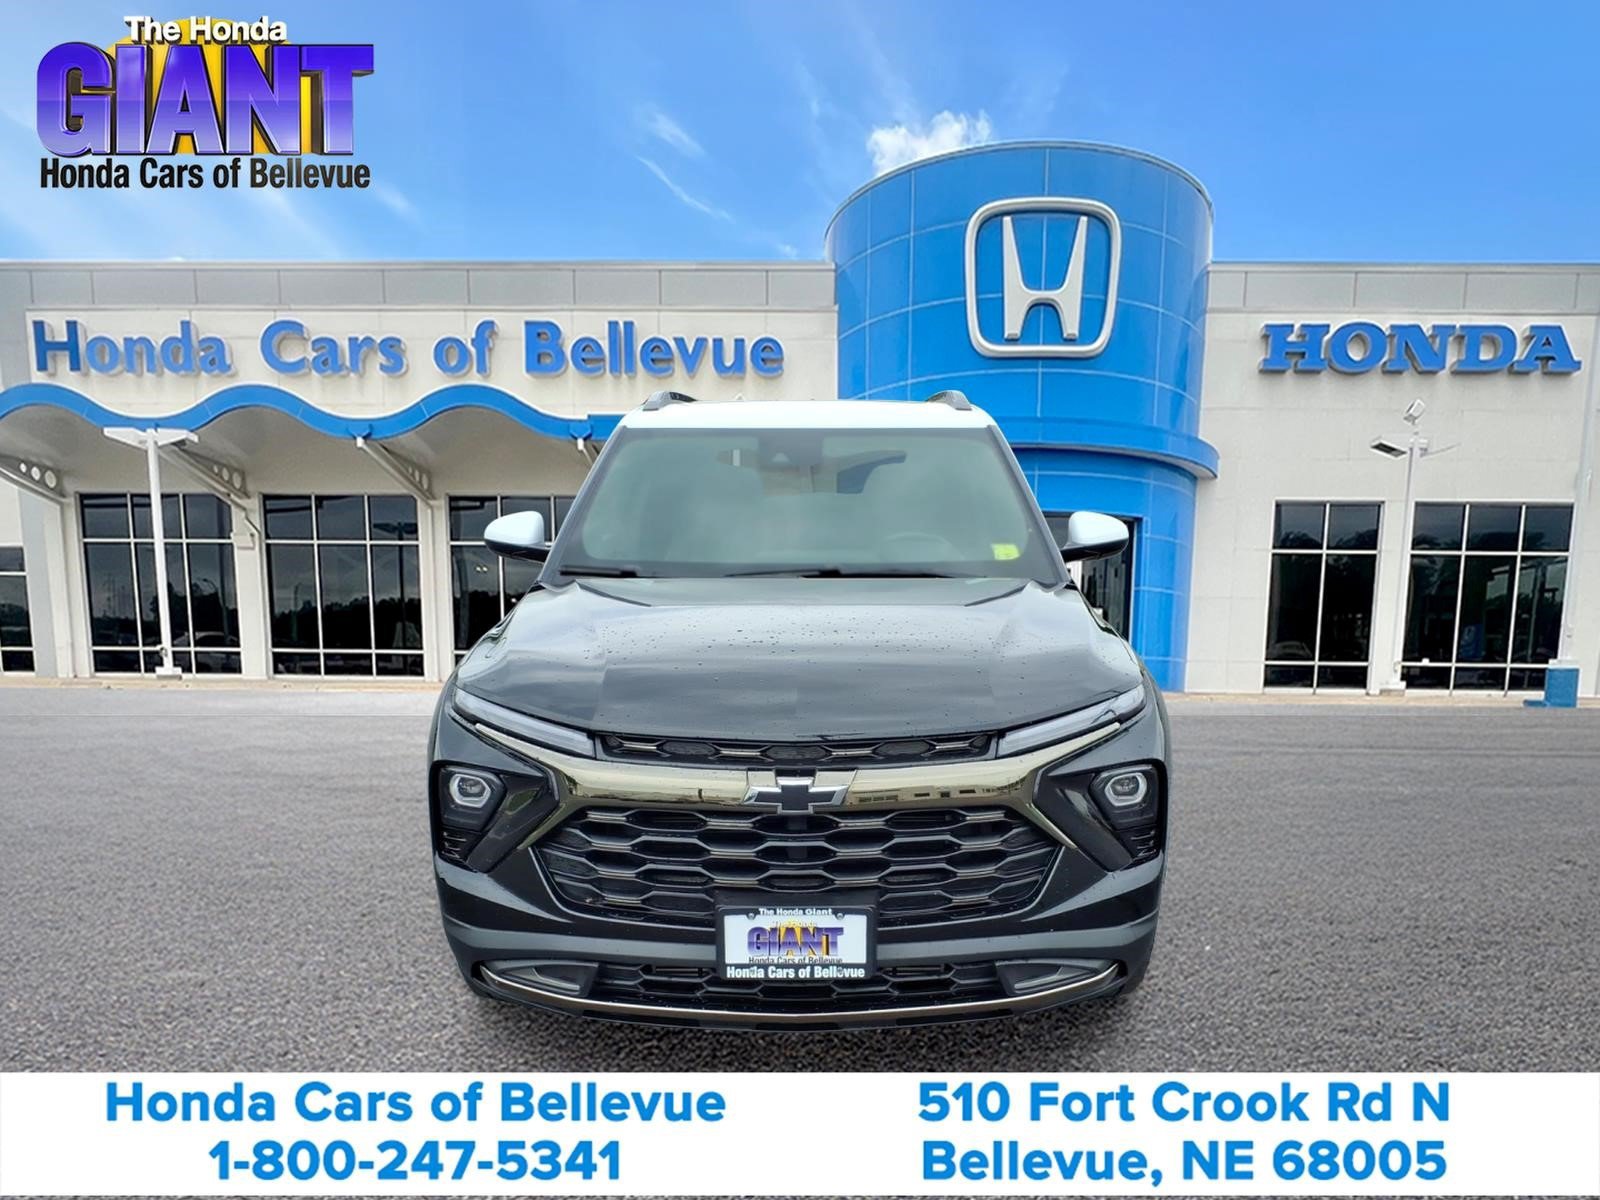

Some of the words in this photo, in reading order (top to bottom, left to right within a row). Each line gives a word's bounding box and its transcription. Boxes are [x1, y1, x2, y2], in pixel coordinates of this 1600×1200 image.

[32, 320, 233, 376] Honda
[260, 320, 406, 376] Cars
[432, 320, 498, 376] of
[523, 320, 785, 378] Bellevue
[1259, 321, 1582, 374] HONDA
[747, 927, 844, 956] GIANT
[727, 966, 763, 979] Honda
[768, 966, 795, 979] Cars
[799, 966, 811, 979] of
